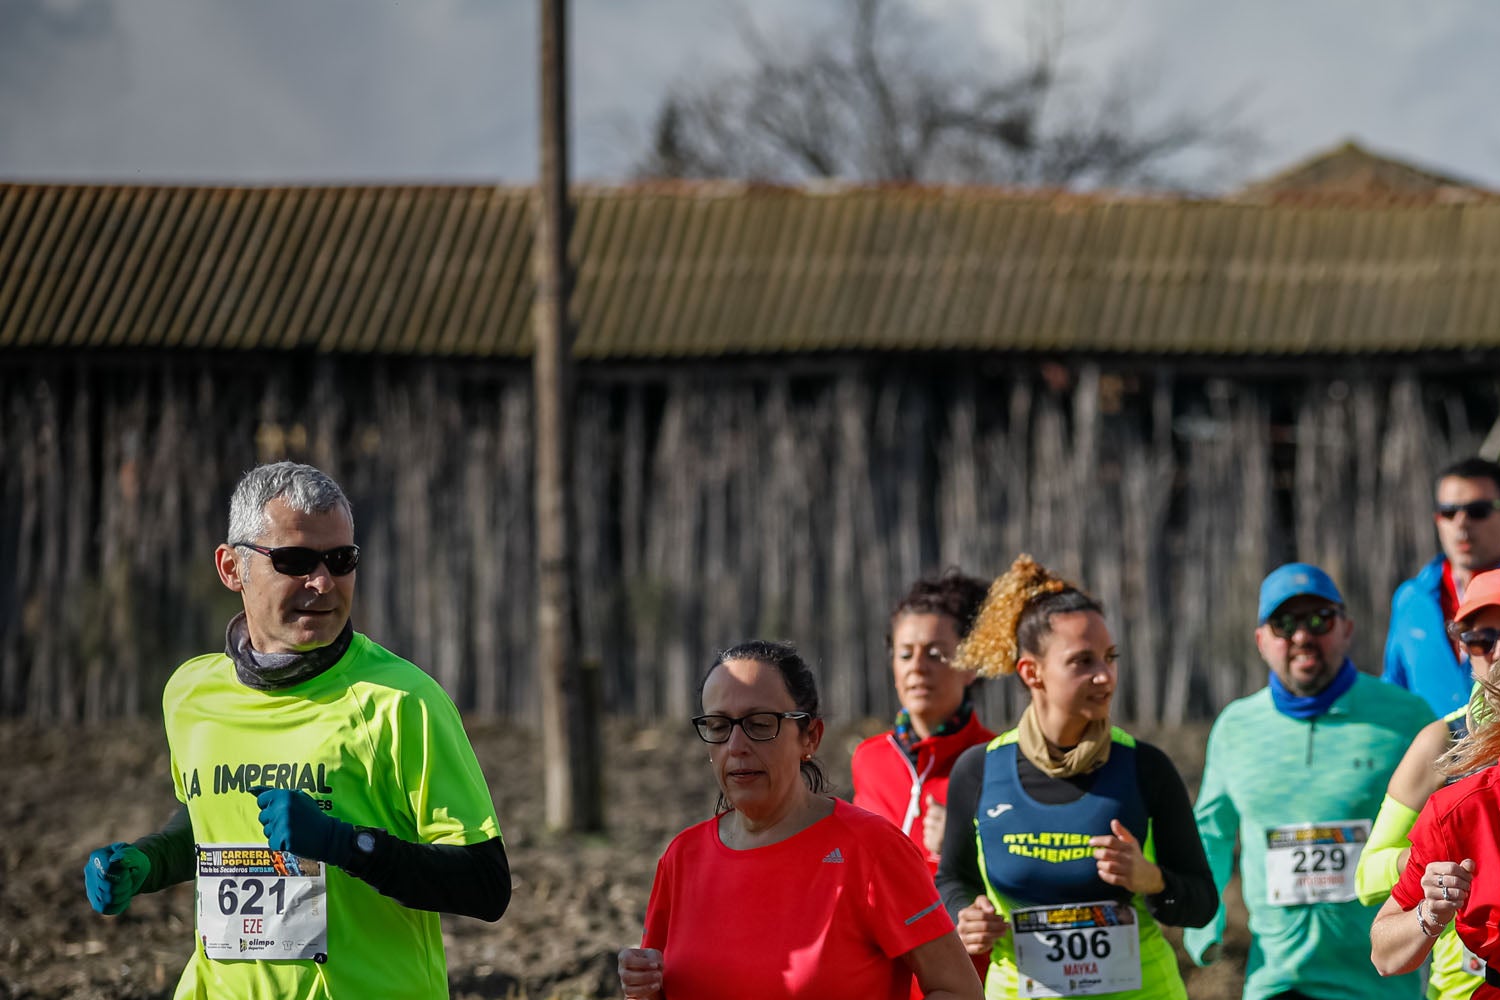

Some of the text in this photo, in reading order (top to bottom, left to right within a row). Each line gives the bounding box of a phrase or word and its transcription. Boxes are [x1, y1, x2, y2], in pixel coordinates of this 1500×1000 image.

[214, 763, 332, 794] IMPERIAL
[222, 850, 270, 859] CARRERA
[1293, 848, 1346, 873] 229
[218, 878, 286, 916] 621
[243, 918, 263, 934] EZE
[1046, 930, 1111, 962] 306
[1063, 962, 1098, 976] MAYKA
